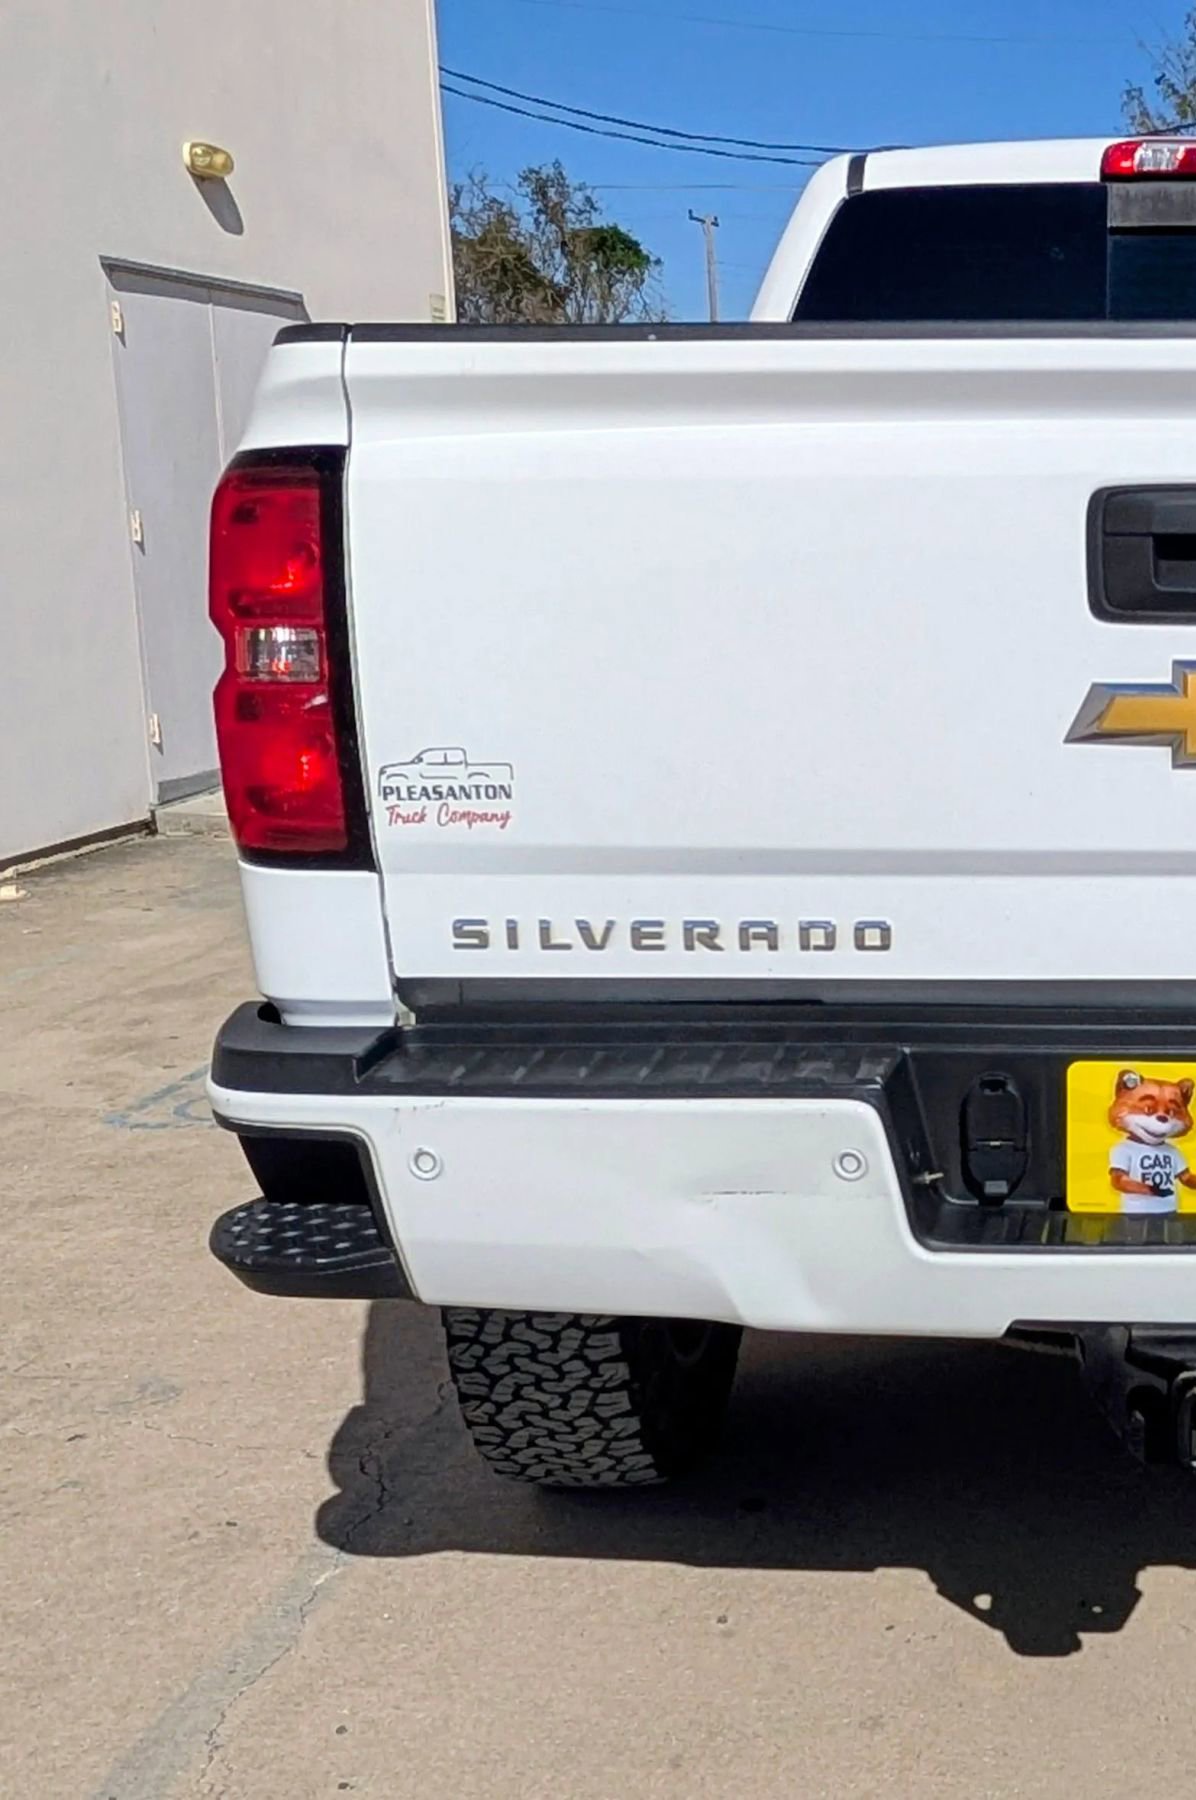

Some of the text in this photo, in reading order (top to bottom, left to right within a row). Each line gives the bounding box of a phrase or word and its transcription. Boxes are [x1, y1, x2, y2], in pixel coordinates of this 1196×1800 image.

[382, 784, 513, 801] PLEASANTON
[385, 802, 512, 830] Truck Company
[452, 918, 893, 952] SILVERADO
[1140, 1154, 1172, 1170] CAR
[1141, 1170, 1174, 1187] FOX
